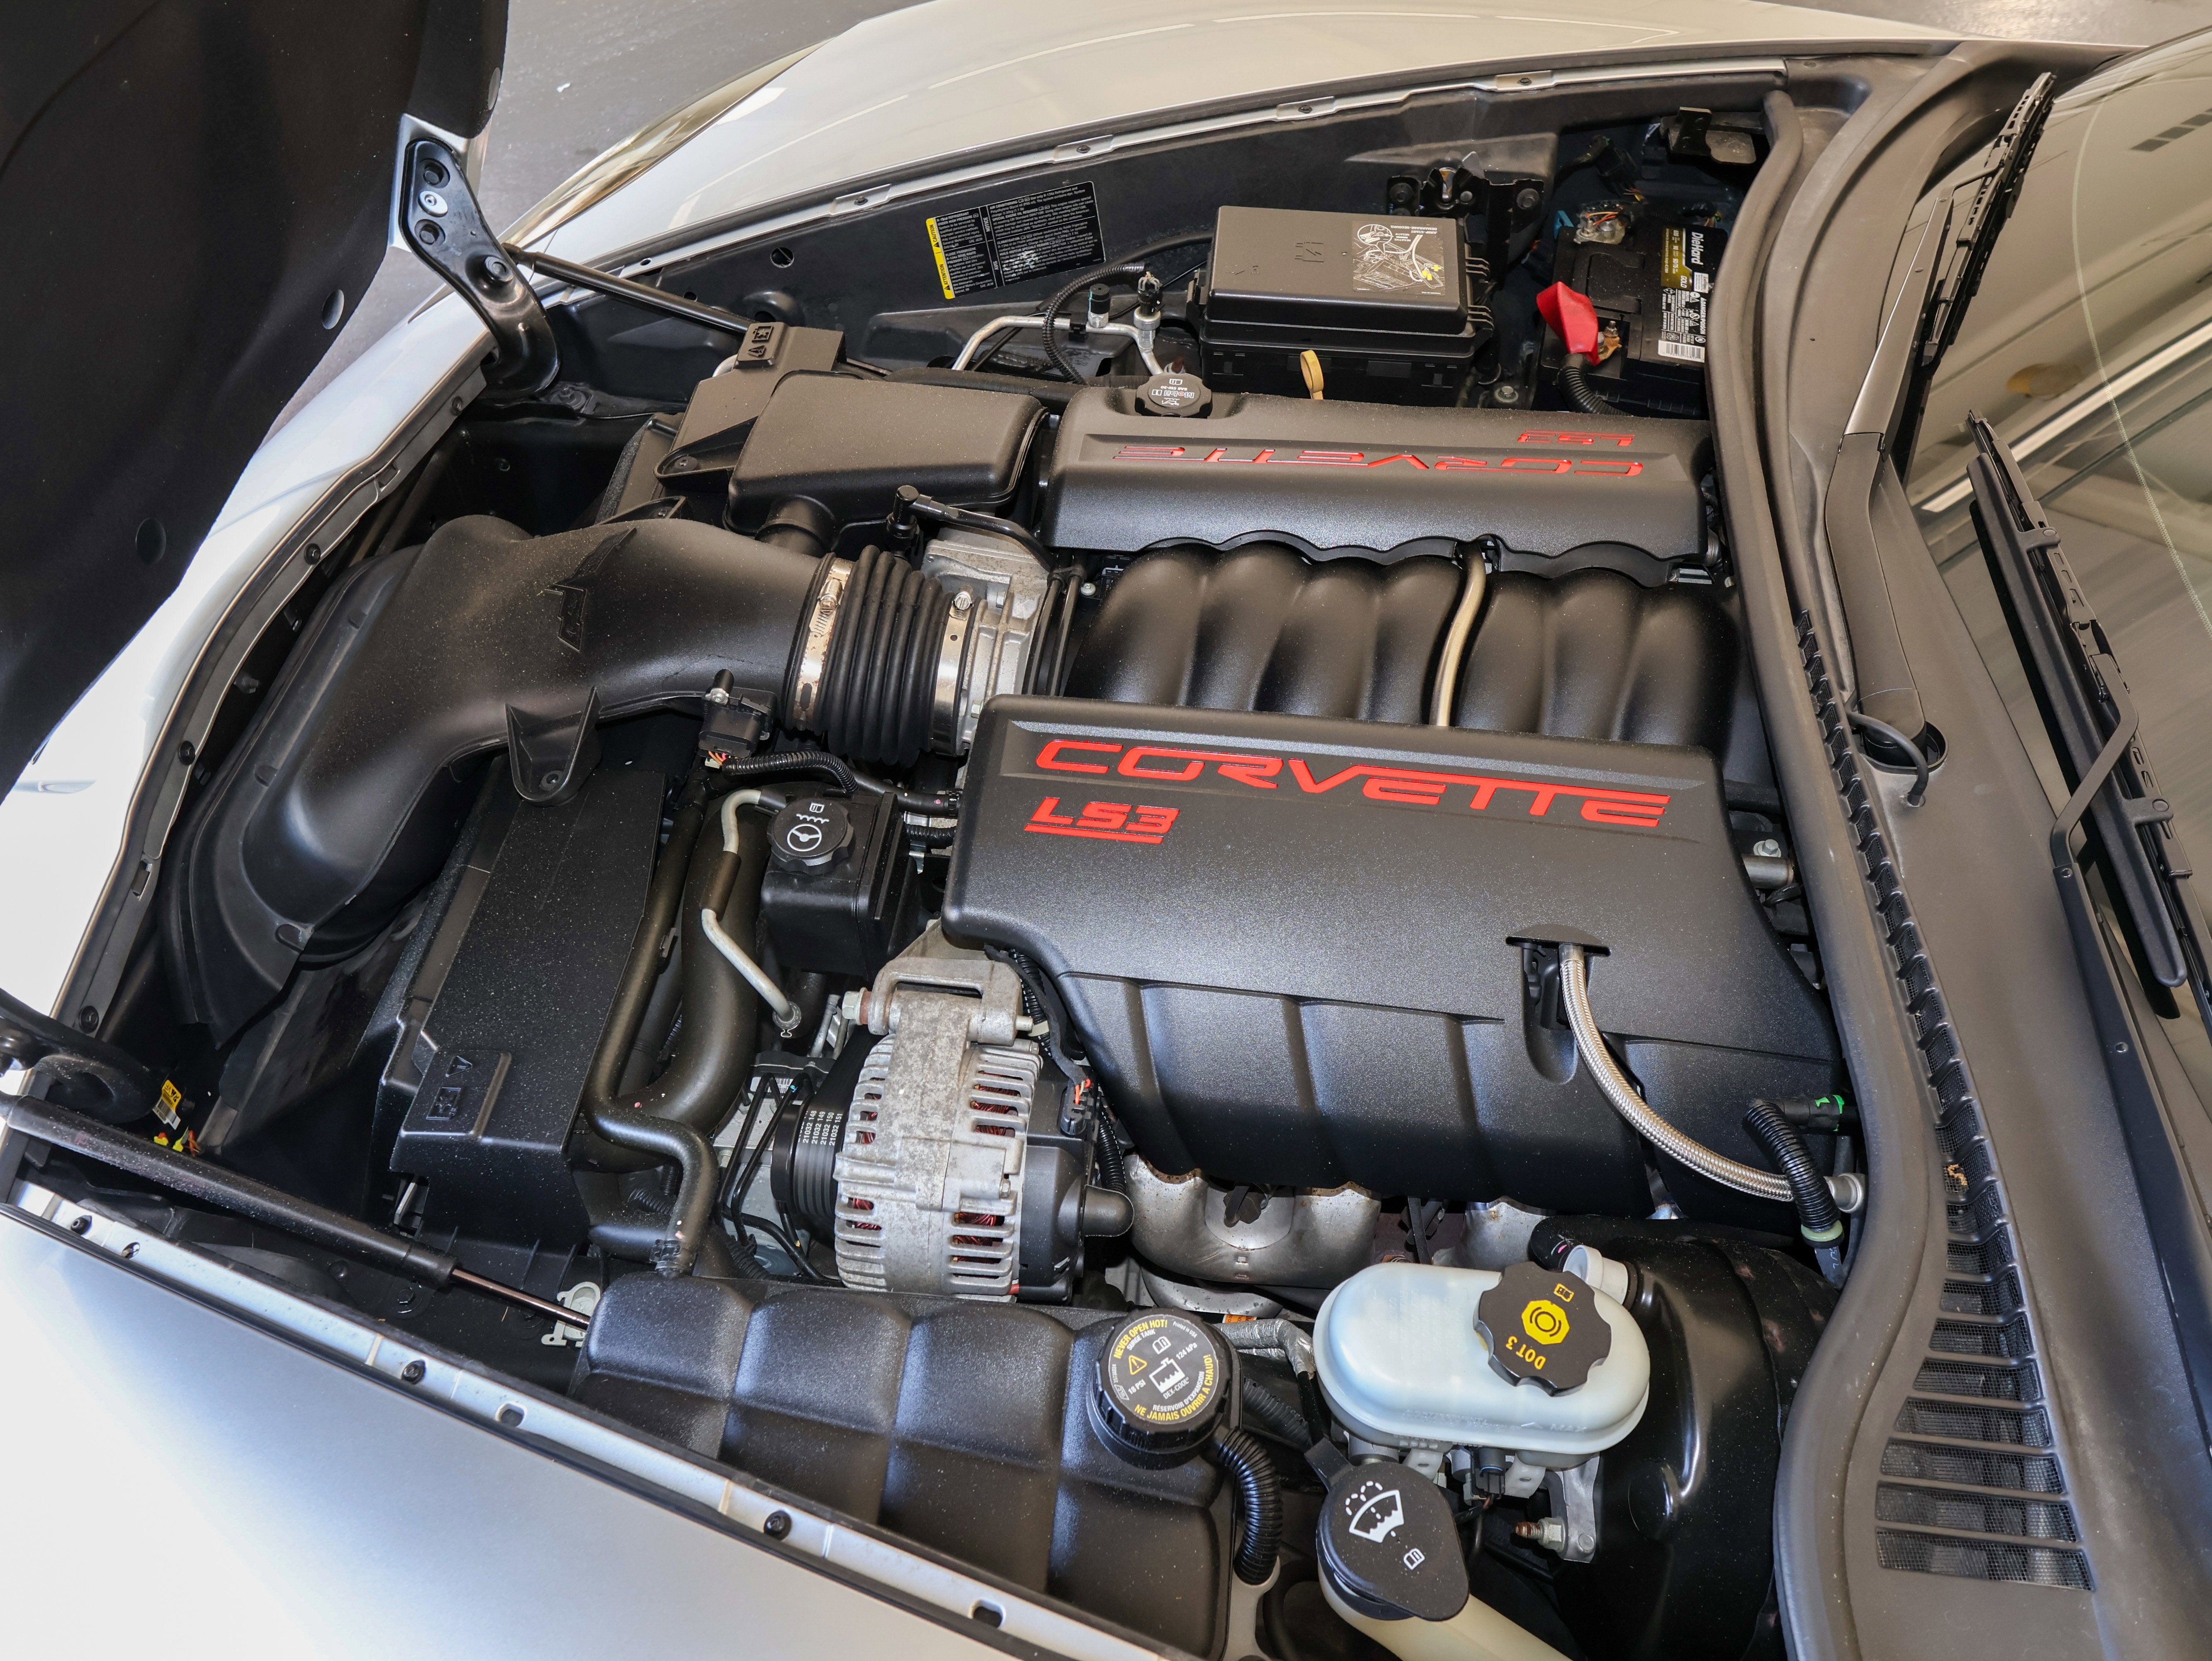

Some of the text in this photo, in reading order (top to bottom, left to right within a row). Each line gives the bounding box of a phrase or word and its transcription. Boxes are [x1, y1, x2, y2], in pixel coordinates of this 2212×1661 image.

[1691, 231, 1704, 265] DieHard
[940, 264, 949, 285] ATTENTION
[1164, 390, 1195, 399] Mobil
[1113, 446, 1644, 476] CORVETTE
[1035, 739, 1670, 827] CORVETTE
[1030, 796, 1180, 835] LS3
[802, 1122, 813, 1144] 21032
[808, 1110, 817, 1120] 148
[811, 1111, 826, 1145] 21032 149
[820, 1112, 834, 1146] 21032 150
[829, 1113, 843, 1146] 21032 151
[1113, 1319, 1168, 1359] NEVER OPEN HOT!
[1127, 1329, 1156, 1350] SURGE TANK
[1172, 1321, 1186, 1330] Printed
[1188, 1329, 1198, 1338] USA
[1176, 1342, 1198, 1360] 124 kPa
[1505, 1335, 1547, 1370] DOT 3
[1128, 1386, 1137, 1394] 18
[1135, 1379, 1146, 1390] PSI
[1134, 1404, 1147, 1416] NE
[1147, 1411, 1180, 1421] JAMAIS
[1180, 1393, 1206, 1417] OUVRIR
[1203, 1354, 1214, 1387] CHAUD!
[1152, 1371, 1204, 1412] RÉSERVOIR D'EXPANSION
[1550, 1423, 1587, 1432] MAX
